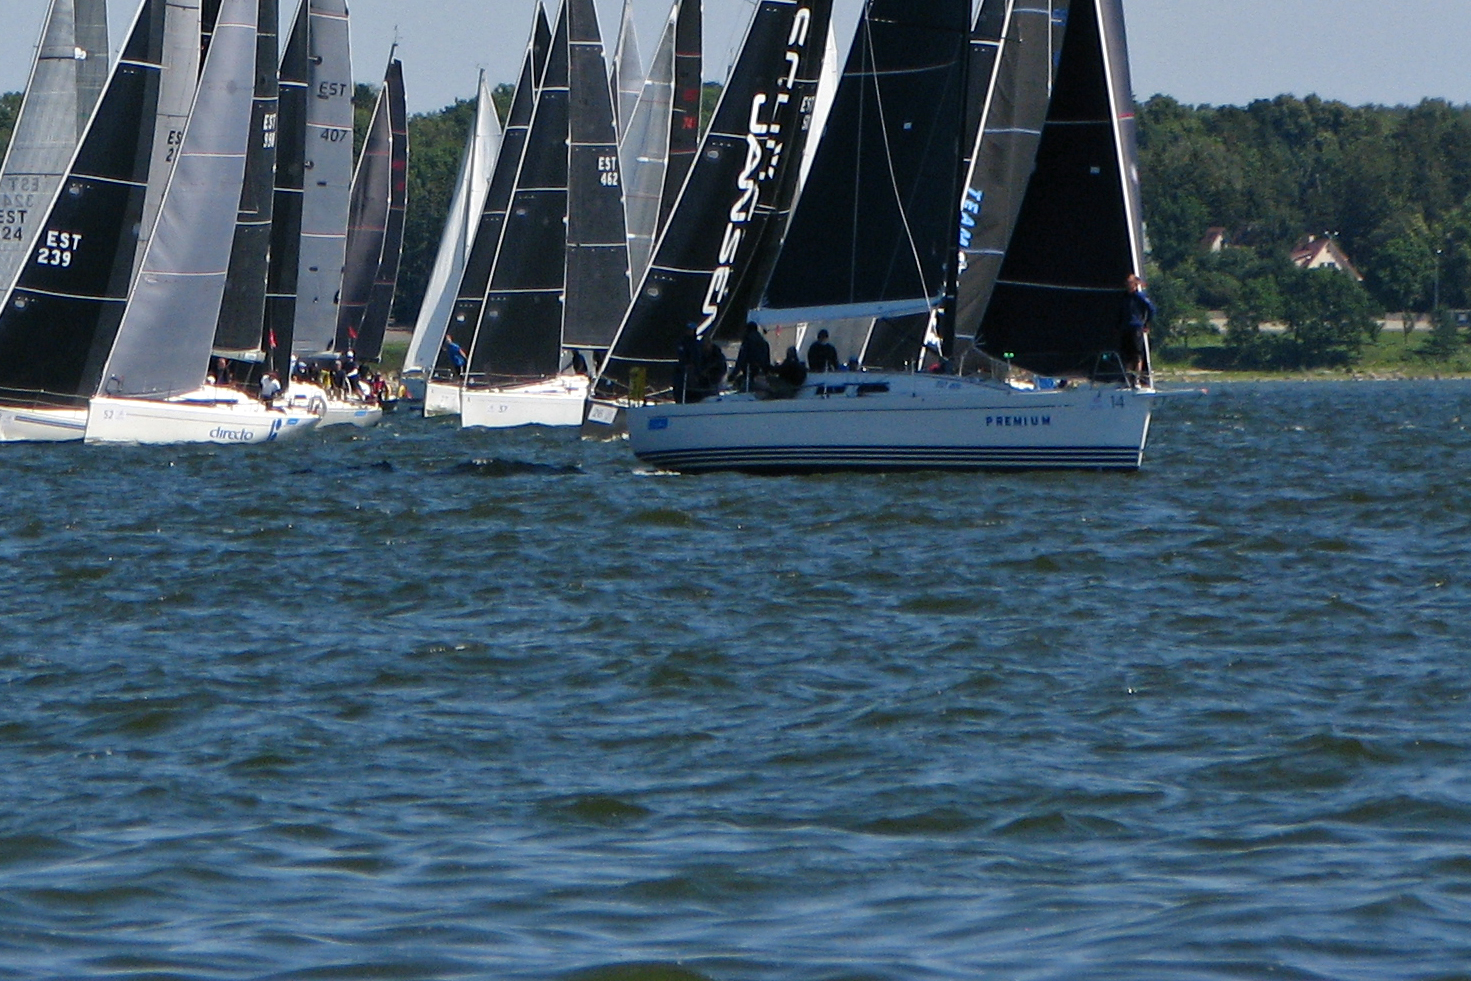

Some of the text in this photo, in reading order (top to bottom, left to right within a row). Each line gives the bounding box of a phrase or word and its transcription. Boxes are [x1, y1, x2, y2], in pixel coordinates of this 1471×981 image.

[319, 82, 347, 97] EST
[167, 130, 182, 145] ES
[320, 129, 348, 143] 407
[598, 156, 617, 171] EST
[600, 172, 618, 186] 462
[957, 186, 984, 248] TEAM
[46, 230, 82, 251] EST
[36, 247, 72, 267] 239
[1110, 395, 1126, 409] 14
[985, 416, 1051, 427] PREMIUM
[209, 426, 254, 441] directo
